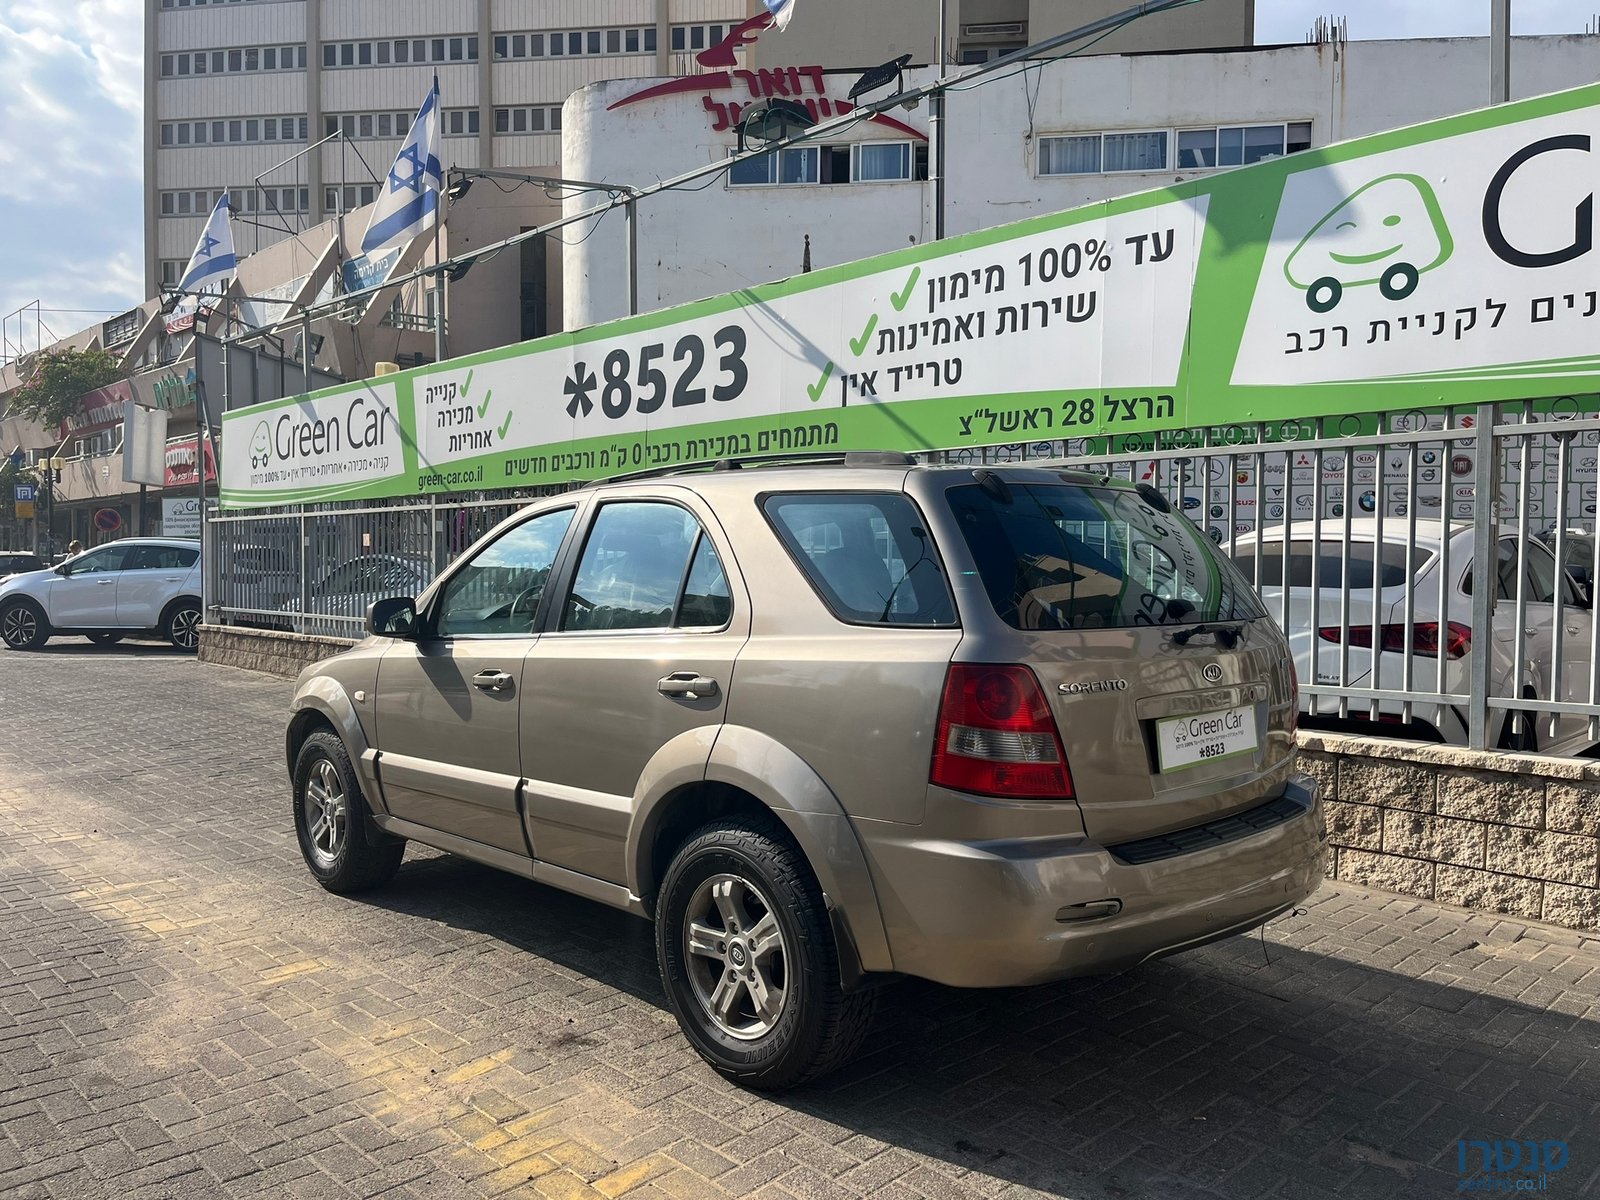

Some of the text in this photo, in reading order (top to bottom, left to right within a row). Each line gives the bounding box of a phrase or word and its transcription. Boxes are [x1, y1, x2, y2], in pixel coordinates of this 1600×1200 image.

[733, 66, 826, 98] דואר
[928, 228, 1175, 314] עד 100% מימון
[876, 290, 1097, 355] שירות ואמינות
[1367, 298, 1507, 343] לקניית
[1284, 325, 1348, 354] רכב
[426, 381, 457, 405] קנייה
[841, 357, 962, 408] טרייד אין
[438, 406, 473, 428] מכירה
[1062, 397, 1095, 426] 28
[1103, 394, 1175, 423] הרצל
[276, 398, 390, 460] Green Car
[449, 430, 492, 453] אחריות
[758, 422, 838, 451] מתמחים
[648, 444, 681, 464] רכבי
[686, 434, 751, 461] במכירת
[300, 466, 316, 478] טרייד
[321, 462, 343, 476] אחריות
[347, 461, 368, 475] מכירה
[373, 456, 389, 471] קניה
[505, 455, 547, 477] חדשים
[552, 451, 595, 473] ורכבים
[265, 471, 279, 483] 100%
[418, 465, 483, 490] green-car.co.il
[1058, 678, 1129, 696] SORENTO
[1189, 711, 1243, 738] Green Car
